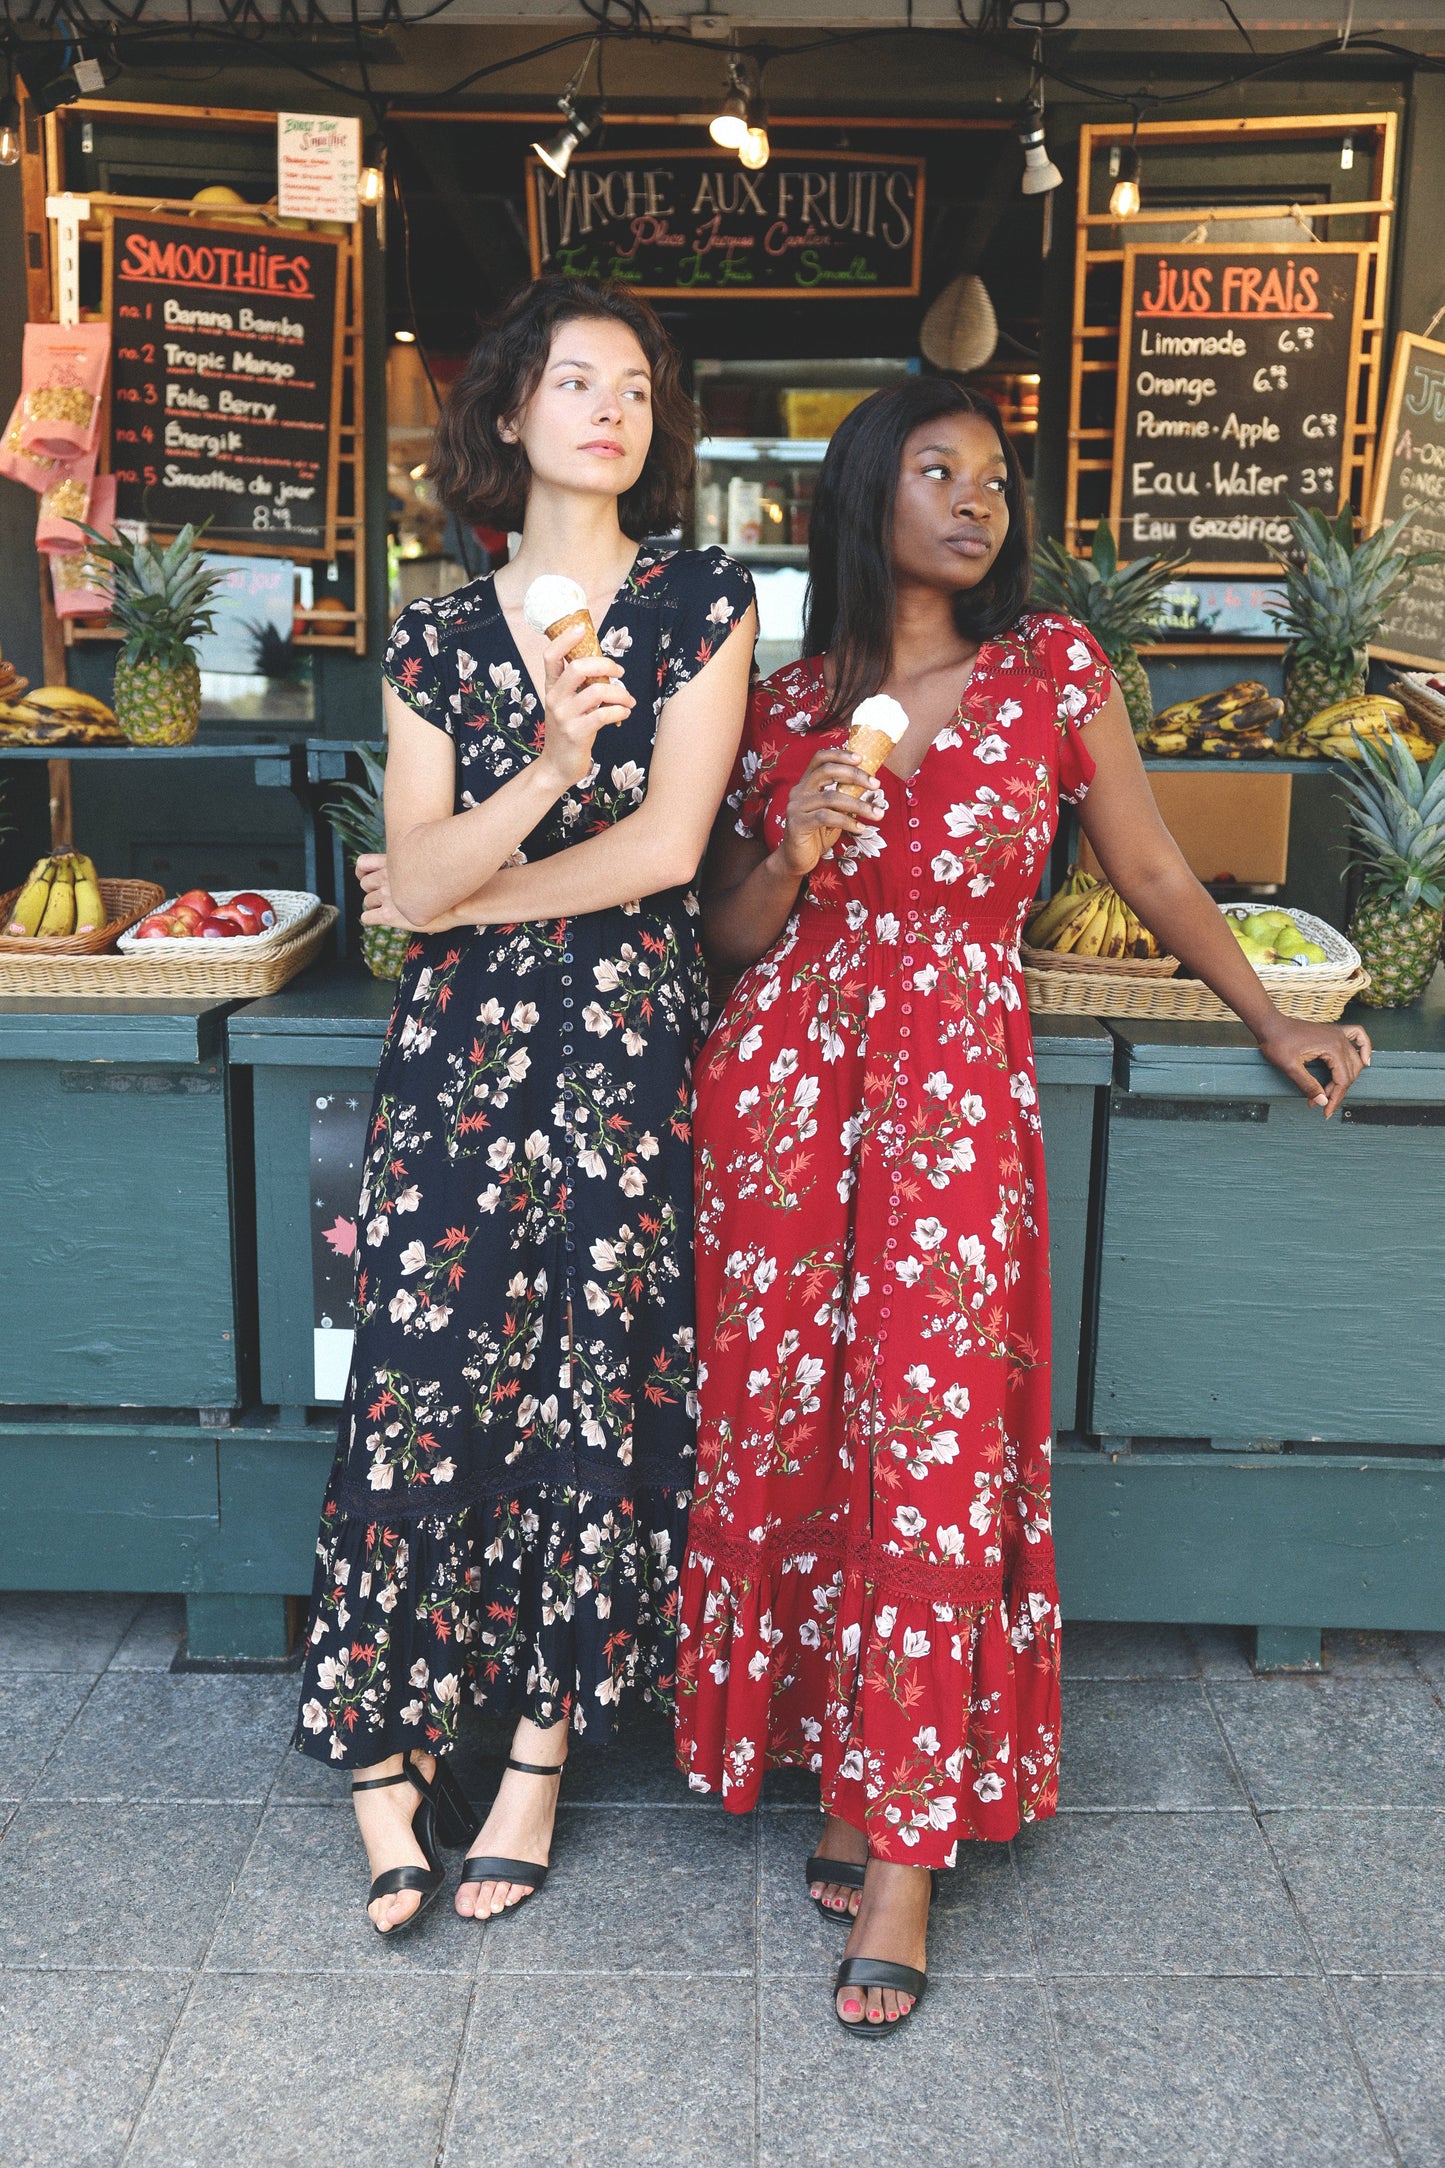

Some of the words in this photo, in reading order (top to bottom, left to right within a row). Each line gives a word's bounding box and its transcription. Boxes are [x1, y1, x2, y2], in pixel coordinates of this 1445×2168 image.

[691, 171, 768, 216] AUX
[778, 170, 914, 249] FRUITS
[120, 233, 311, 294] SMOOTHIES
[1142, 259, 1213, 312] JUS
[1221, 259, 1320, 312] FRAIS
[163, 299, 233, 330] Banana
[239, 308, 304, 339] Bamba
[1140, 328, 1247, 357] Limonade
[163, 343, 226, 374] Tropic
[232, 351, 295, 381] Mango
[165, 383, 210, 411] Folie
[218, 390, 277, 420] Berry
[1136, 371, 1217, 406] Orange
[164, 420, 243, 457] Énergik
[1136, 410, 1210, 438] Pomme
[1221, 412, 1281, 449] Apple
[162, 464, 246, 494] Smoothie
[248, 474, 273, 496] du
[273, 481, 316, 507] jour
[1132, 461, 1201, 497] Eau
[1213, 461, 1288, 497] Water
[1133, 512, 1177, 542] Eau
